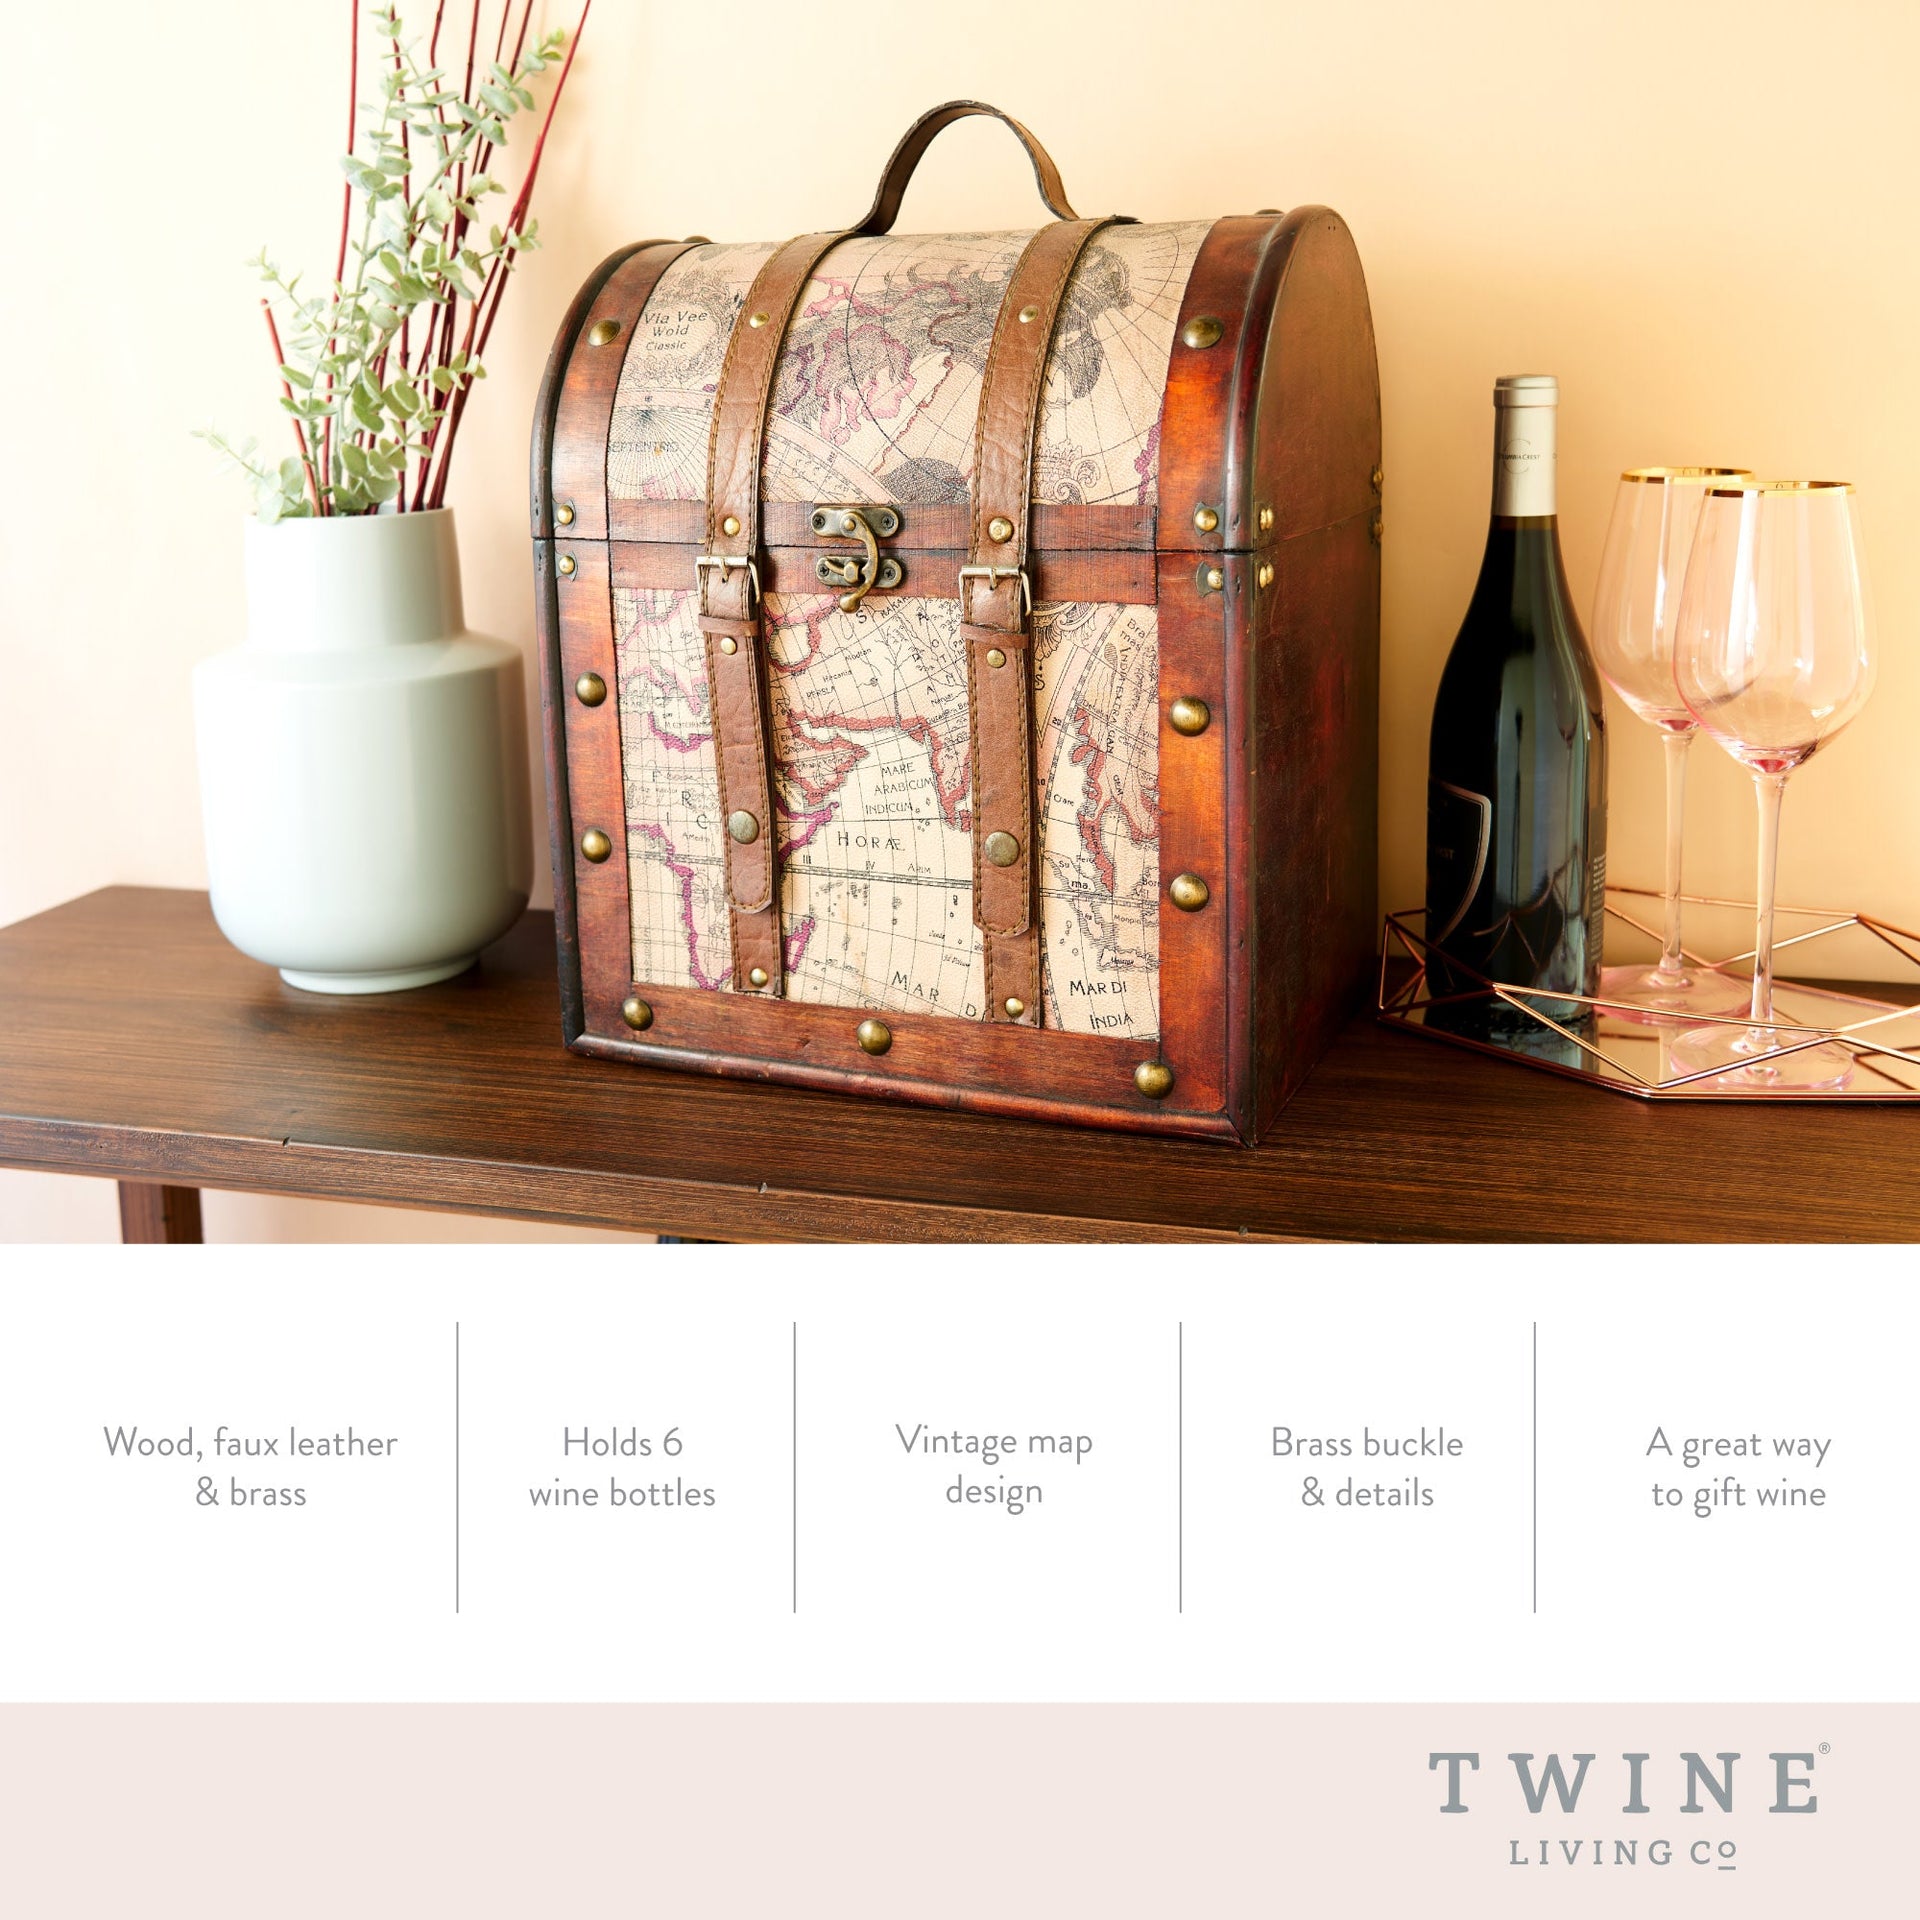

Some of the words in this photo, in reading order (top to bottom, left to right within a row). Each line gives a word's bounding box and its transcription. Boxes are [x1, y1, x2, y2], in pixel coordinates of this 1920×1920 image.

[644, 312, 670, 325] Via
[678, 310, 708, 323] Vee
[881, 762, 916, 777] MARE
[873, 777, 934, 797] ARABICUM
[865, 801, 913, 816] INDICUM
[1089, 1012, 1134, 1030] INDIA
